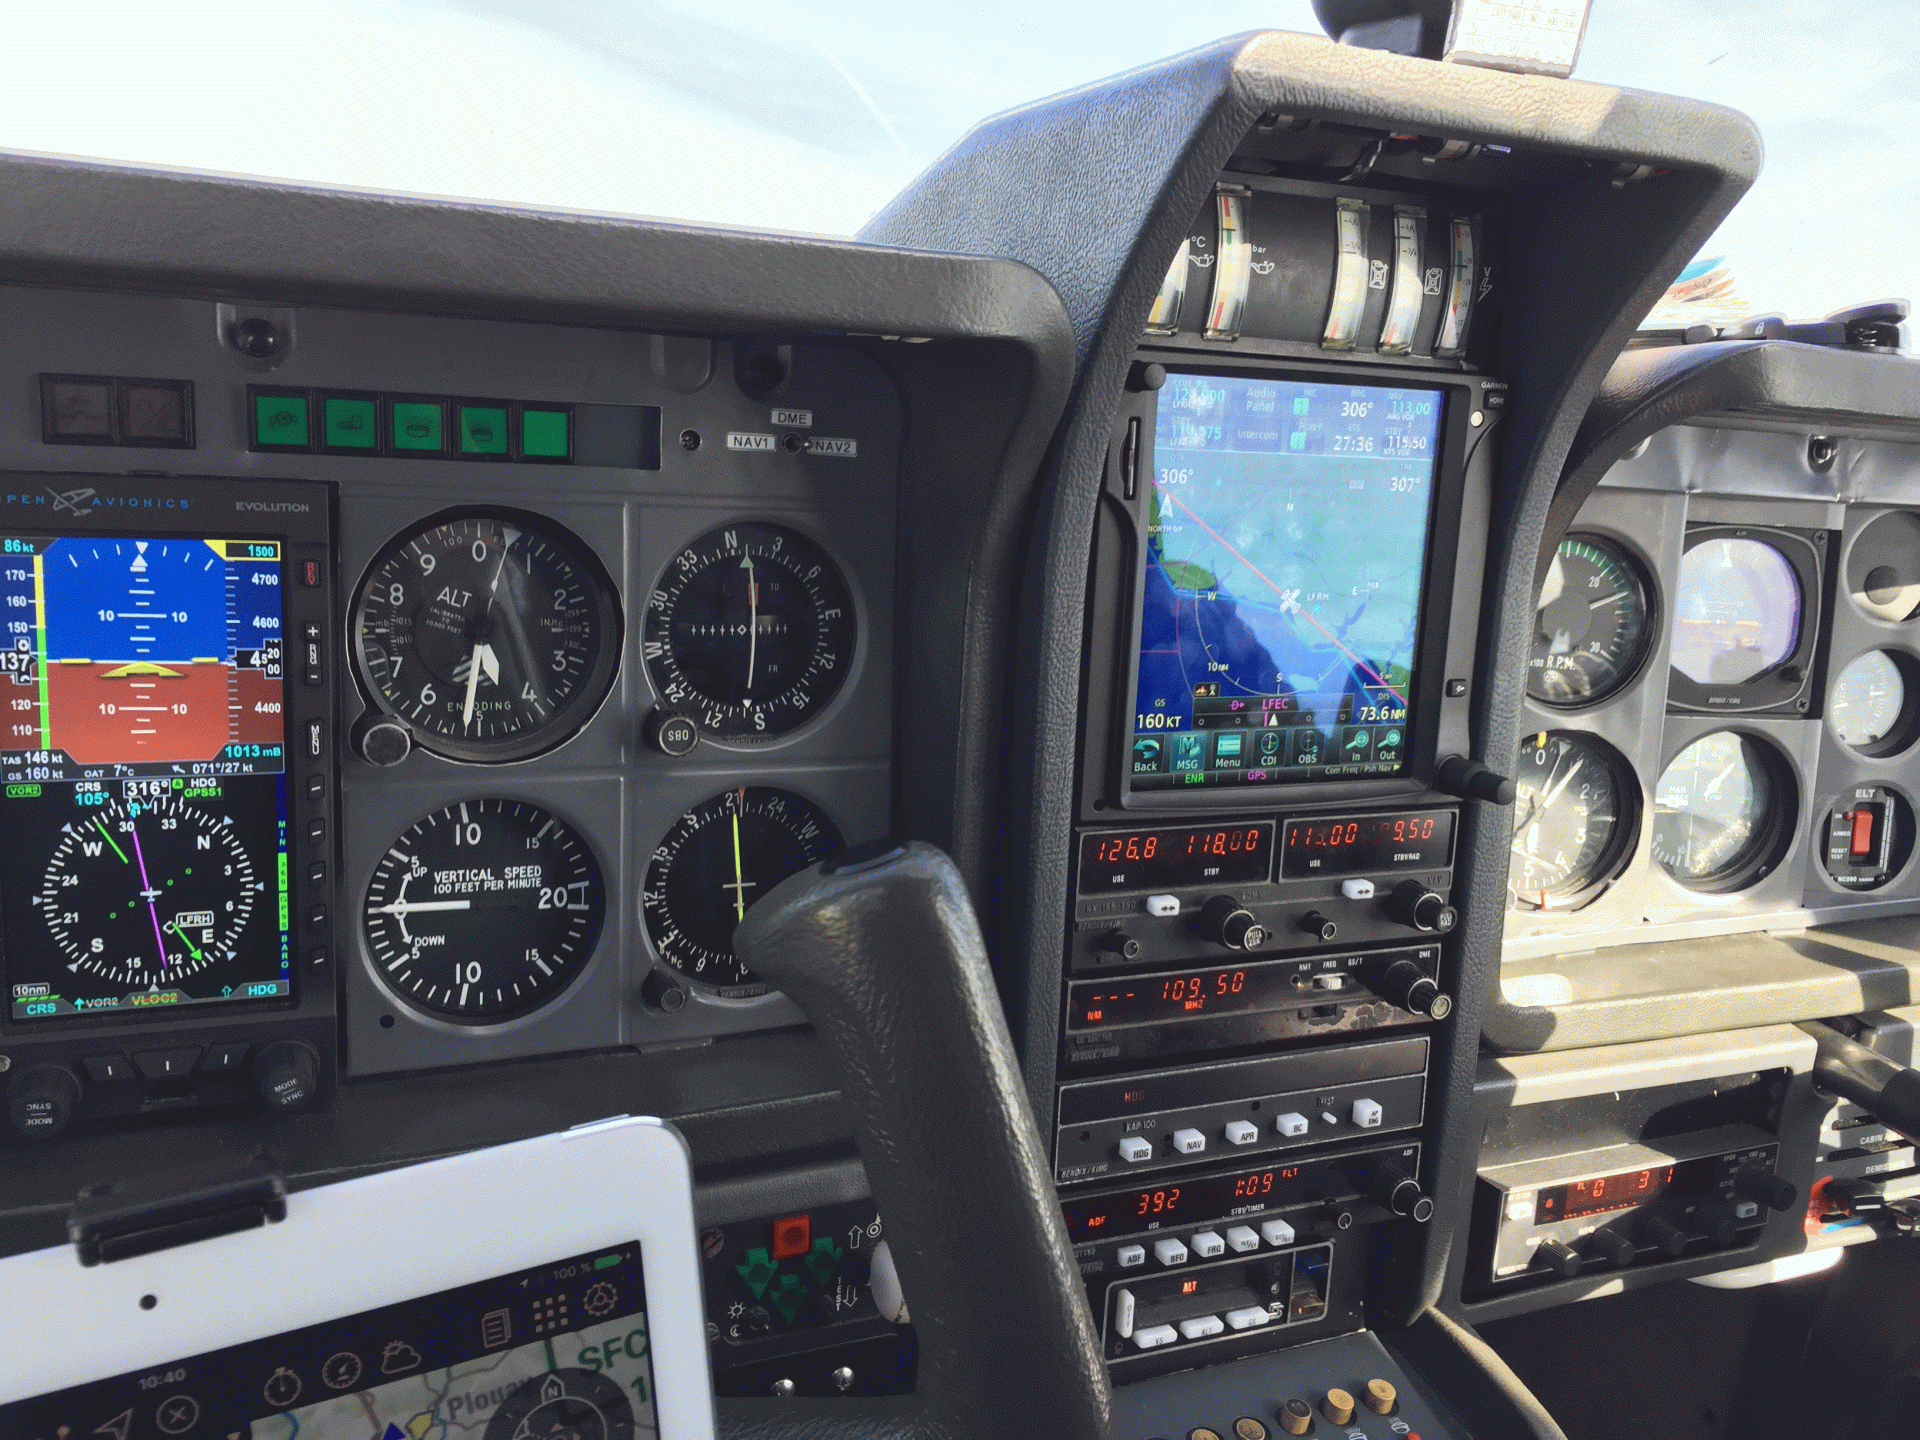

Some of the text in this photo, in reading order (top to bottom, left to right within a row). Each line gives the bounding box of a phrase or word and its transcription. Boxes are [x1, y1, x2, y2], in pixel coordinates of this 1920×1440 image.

[1252, 245, 1266, 254] bar
[1247, 388, 1276, 398] Audio
[1247, 400, 1274, 412] Panel
[1341, 402, 1373, 417] 306°
[1392, 401, 1430, 415] 113.00
[778, 413, 807, 424] DME
[734, 437, 769, 448] NAV1
[816, 442, 850, 452] NAV2
[1334, 436, 1373, 451] 27:36
[1388, 436, 1427, 449] 115.50
[1159, 468, 1194, 484] 306°
[1390, 477, 1420, 491] 307°
[91, 496, 189, 509] AVIONICS
[235, 501, 310, 512] EVOLUTION
[248, 545, 274, 556] 1500
[676, 550, 698, 571] 33
[5, 570, 26, 580] 170
[251, 574, 278, 585] 4700
[1588, 576, 1600, 588] 20
[6, 596, 26, 606] 160
[437, 586, 472, 608] ALT
[650, 590, 669, 611] 30
[98, 610, 115, 621] 10
[171, 612, 188, 622] 10
[7, 622, 28, 633] 150
[252, 617, 279, 628] 4600
[1589, 641, 1601, 653] 30
[1546, 655, 1576, 670] R.P.M.
[665, 682, 685, 703] 24
[1378, 693, 1390, 701] DIS
[11, 699, 31, 710] 120
[792, 692, 810, 708] 15
[1154, 699, 1166, 707] GS
[1262, 699, 1288, 710] LFEC
[99, 704, 115, 714] 10
[171, 704, 188, 714] 10
[254, 702, 281, 713] 4400
[447, 701, 511, 711] ENODING
[705, 711, 723, 727] 21
[1360, 707, 1388, 721] 73.6
[12, 725, 32, 736] 110
[311, 725, 320, 755] MENU
[225, 746, 281, 758] 1013 mB
[1352, 752, 1361, 761] In
[1379, 750, 1396, 760] Out
[2, 751, 63, 765] TAS 146 kt
[1216, 758, 1240, 768] Menu
[1261, 756, 1277, 766] CDI
[1298, 754, 1317, 764] OBS
[242, 763, 253, 774] kt
[1134, 761, 1157, 772] Back
[1177, 759, 1198, 770] MSG
[1325, 766, 1340, 774] Com
[1379, 763, 1391, 771] Nav
[8, 767, 63, 780] GS 160 kt
[84, 769, 104, 778] OAT
[1185, 773, 1204, 783] ENR
[1247, 770, 1266, 781] GPS
[75, 781, 101, 792] CRS
[127, 779, 169, 796] 316°
[190, 778, 217, 788] HDG
[9, 786, 39, 796] VOR2
[184, 787, 222, 798] GPSS1
[1855, 788, 1876, 798] ELT
[75, 792, 109, 806] 105°
[768, 797, 785, 812] 24
[119, 821, 135, 832] 30
[162, 819, 177, 829] 33
[456, 823, 481, 845] 10
[526, 837, 539, 849] 15
[652, 847, 669, 861] 15
[1099, 837, 1157, 861] 126.8
[1309, 859, 1321, 867] USE
[413, 867, 428, 878] UP
[434, 865, 542, 884] VERTICAL SPEED
[1204, 867, 1220, 876] STBY
[62, 876, 78, 886] 24
[1112, 874, 1125, 883] USE
[434, 877, 542, 894] 100 FEET PER MINUTE
[538, 887, 568, 909] 20
[644, 891, 659, 908] 12
[64, 913, 78, 923] 21
[178, 914, 210, 924] LFRH
[414, 935, 445, 947] DOWN
[168, 954, 182, 964] 12
[525, 949, 539, 961] 15
[126, 958, 141, 968] 15
[1323, 960, 1337, 969] FREQ
[456, 961, 482, 984] 10
[15, 985, 47, 995] 10nm
[248, 984, 277, 995] HDG
[86, 997, 118, 1007] VOR2
[26, 1003, 56, 1015] CRS
[1086, 1010, 1102, 1021] NM
[1127, 1120, 1156, 1132] KAP 100
[1293, 1124, 1303, 1132] BC
[1241, 1132, 1255, 1141] APR
[1860, 1133, 1883, 1145] CABIN
[1186, 1141, 1202, 1150] NAV
[1133, 1149, 1149, 1158] HDG
[1061, 1164, 1108, 1179] BENDIX/KING
[1282, 1167, 1298, 1178] FLT
[1138, 1188, 1180, 1215] 392
[1231, 1204, 1265, 1215] STBY/TIMER
[1088, 1216, 1106, 1227] ADF
[1207, 1245, 1221, 1254] FRQ
[1127, 1255, 1142, 1264] ADF
[1170, 1253, 1184, 1263] BFO
[553, 1264, 577, 1281] 100
[1182, 1280, 1197, 1293] ALT
[138, 1367, 188, 1391] 10:40
